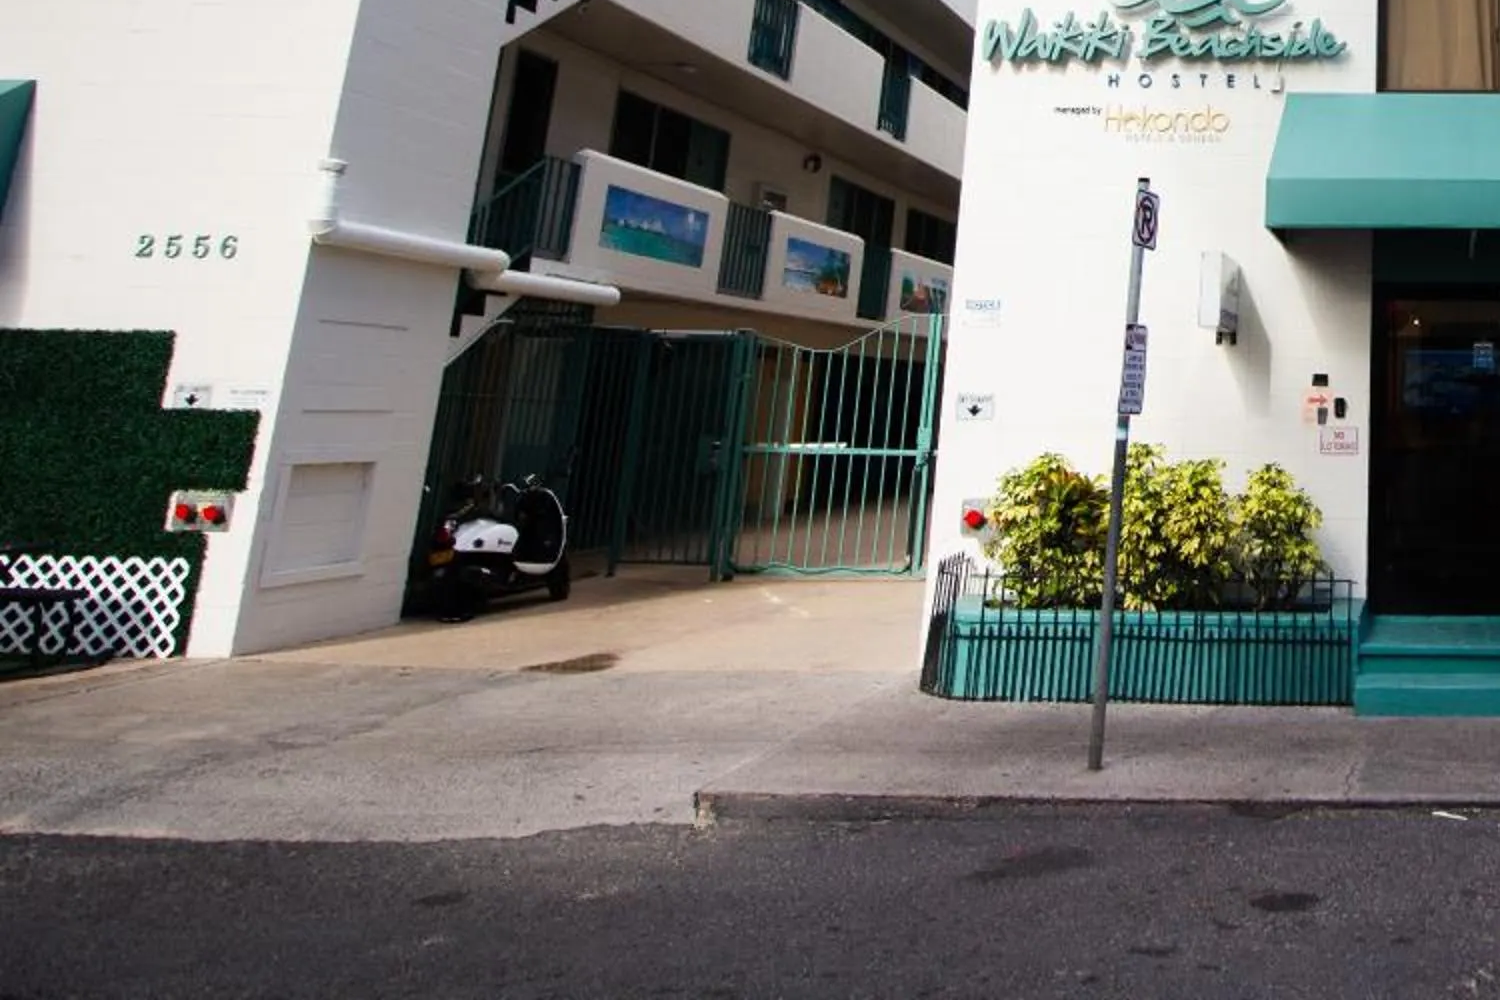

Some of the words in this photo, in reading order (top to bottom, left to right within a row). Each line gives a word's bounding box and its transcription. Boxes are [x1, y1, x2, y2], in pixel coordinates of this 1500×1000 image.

[983, 7, 1131, 62] Waikiki
[1137, 15, 1346, 59] Beachside
[1108, 74, 1260, 88] HOSTEL
[135, 234, 238, 259] 2556
